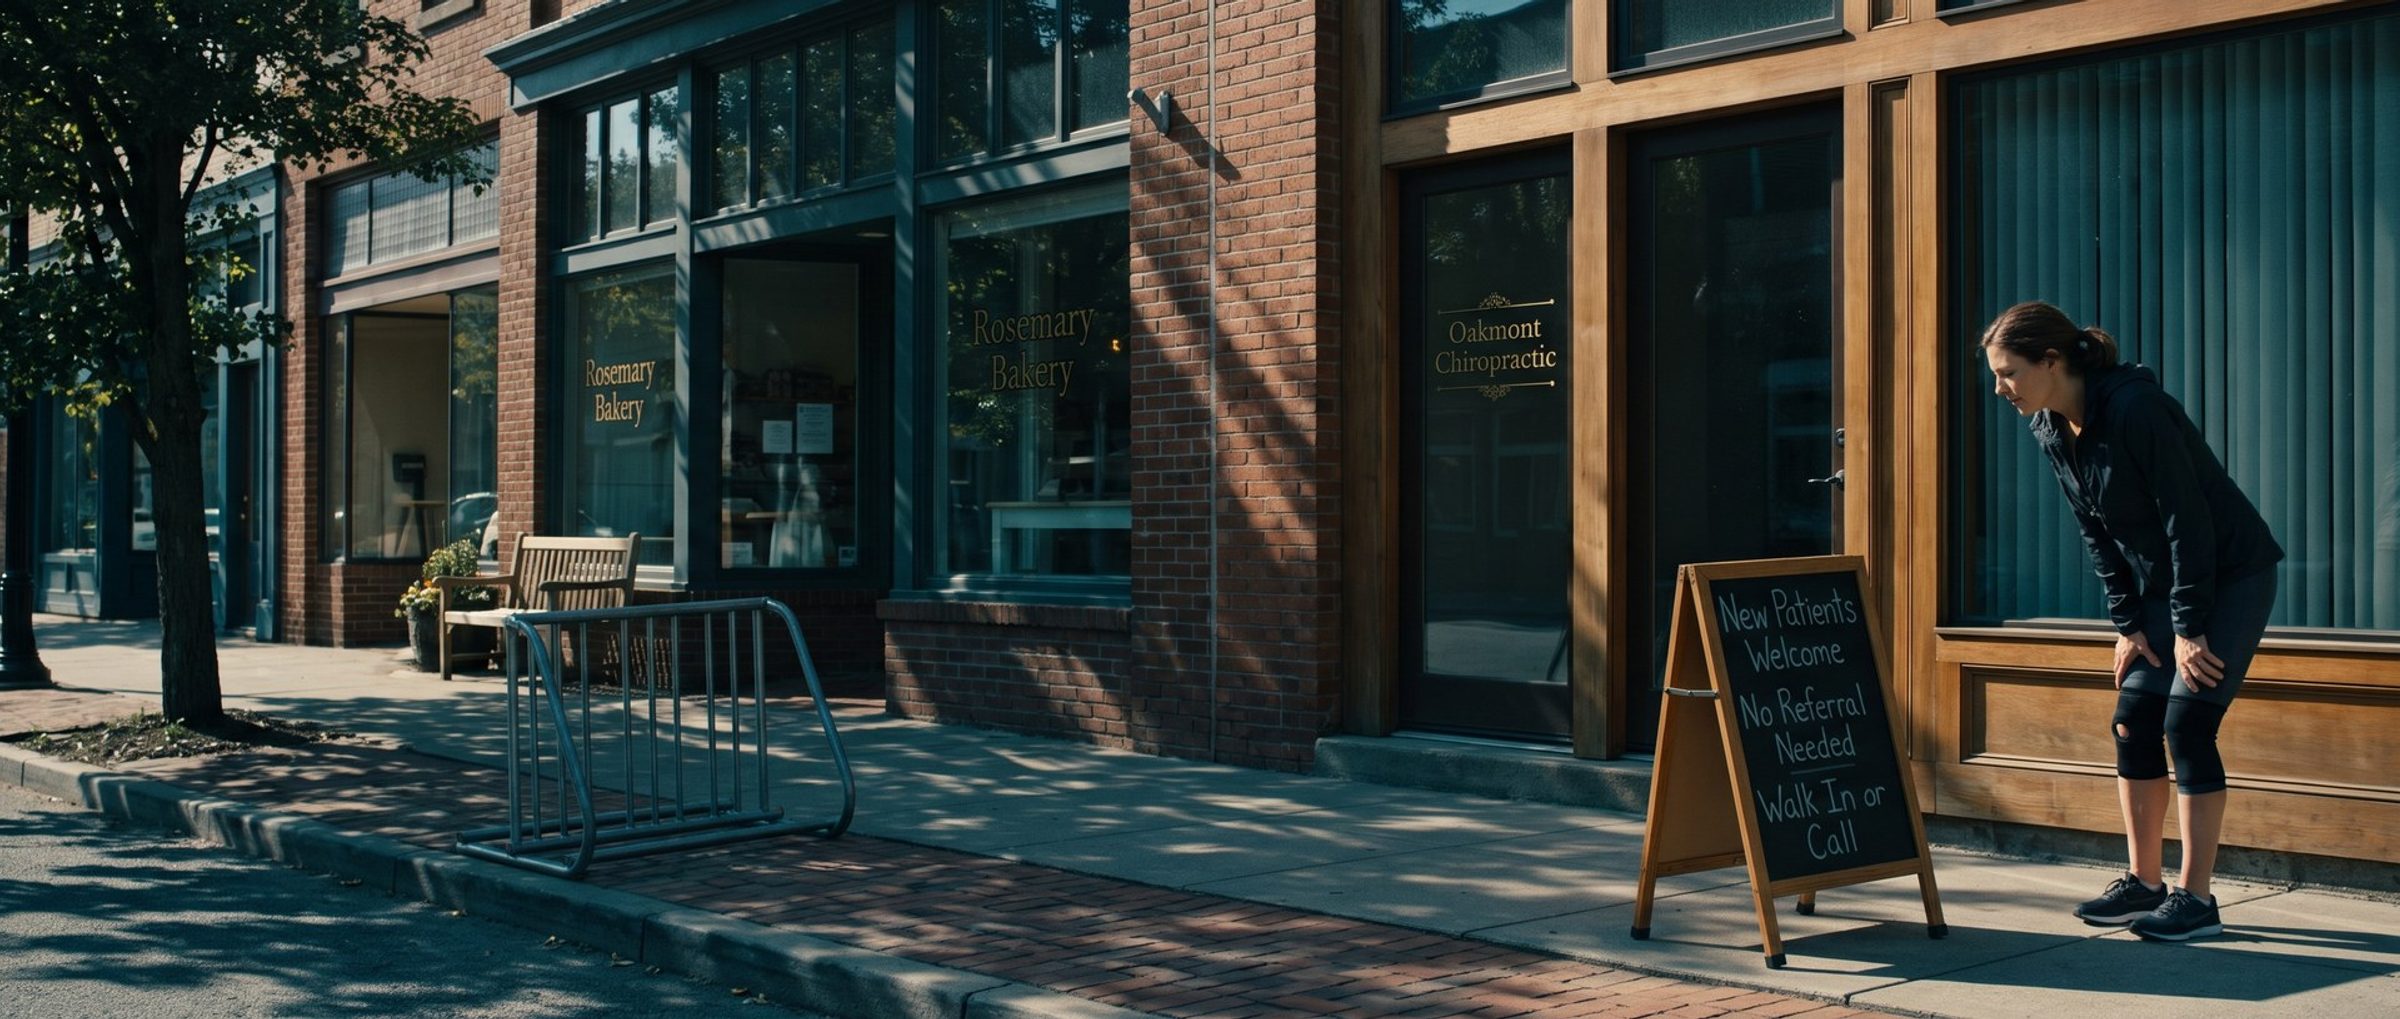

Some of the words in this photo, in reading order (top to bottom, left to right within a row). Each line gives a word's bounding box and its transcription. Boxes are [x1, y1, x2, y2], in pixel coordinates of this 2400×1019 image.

[974, 308, 1095, 346] Rosemary
[1449, 319, 1542, 344] Oakmont
[585, 358, 656, 390] Rosemary
[991, 351, 1075, 397] Bakery
[1435, 344, 1557, 378] Chiropractic
[595, 391, 644, 428] Bakery
[1718, 592, 1768, 633] New
[1771, 587, 1857, 628] Patients
[1744, 635, 1845, 673] Welcome
[1739, 692, 1774, 730] No
[1777, 682, 1867, 724] Referral
[1775, 723, 1856, 765] Needed
[1756, 784, 1820, 823] Walk
[1820, 777, 1857, 814] In
[1863, 786, 1886, 808] or
[1807, 818, 1858, 860] Call
